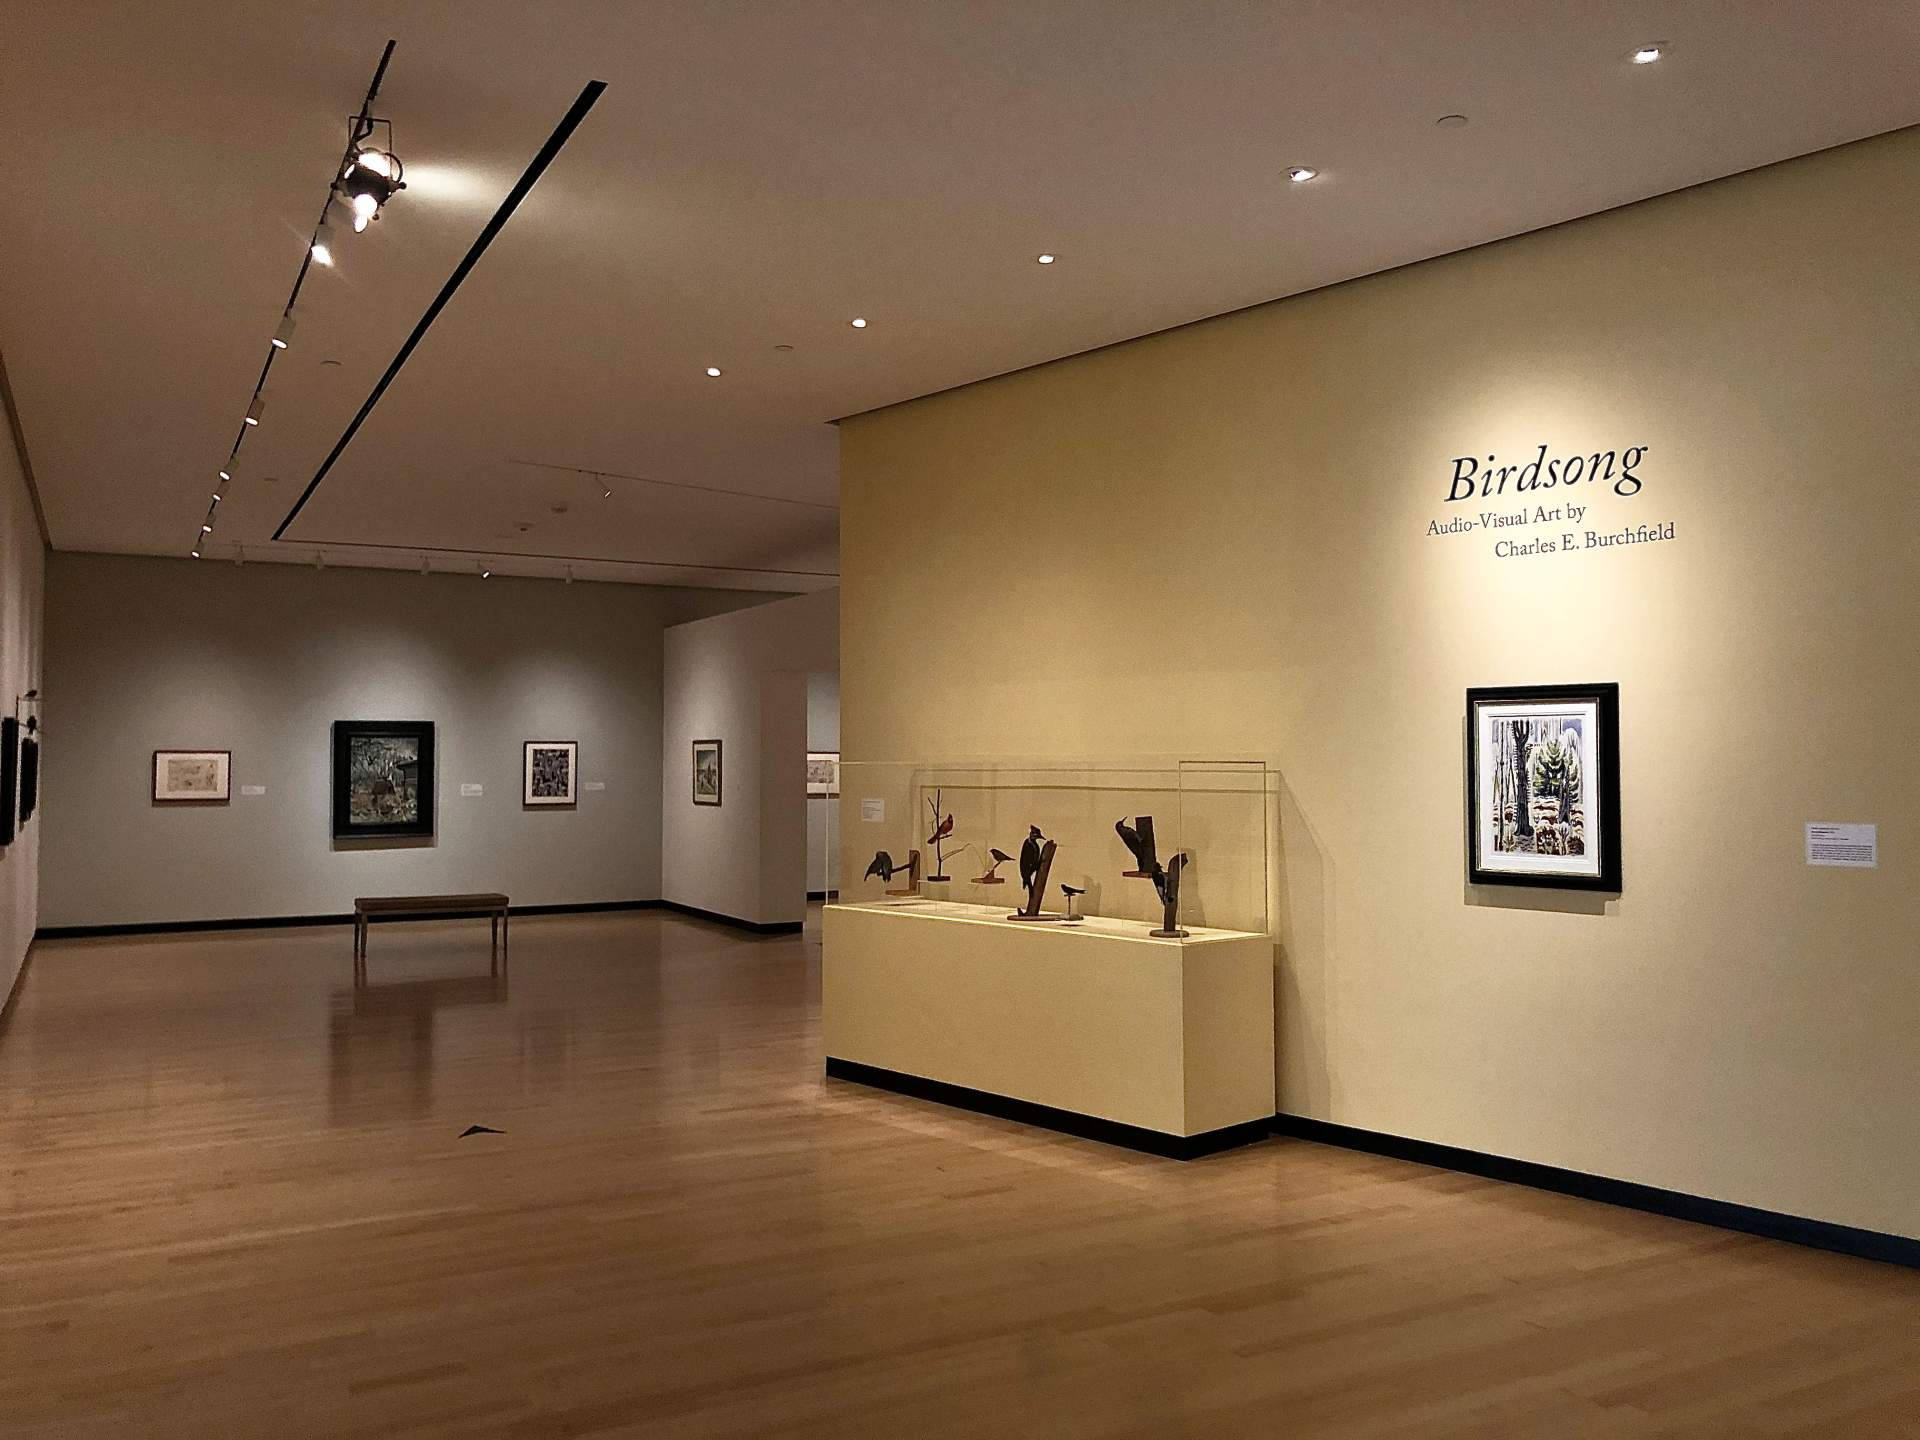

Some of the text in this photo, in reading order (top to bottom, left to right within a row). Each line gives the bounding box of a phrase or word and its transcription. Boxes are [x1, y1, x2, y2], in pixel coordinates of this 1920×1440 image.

[1444, 445, 1648, 503] Birdsong
[1427, 503, 1587, 537] Audio-Visual Art by
[1495, 522, 1675, 558] Charles E. Burchfield
